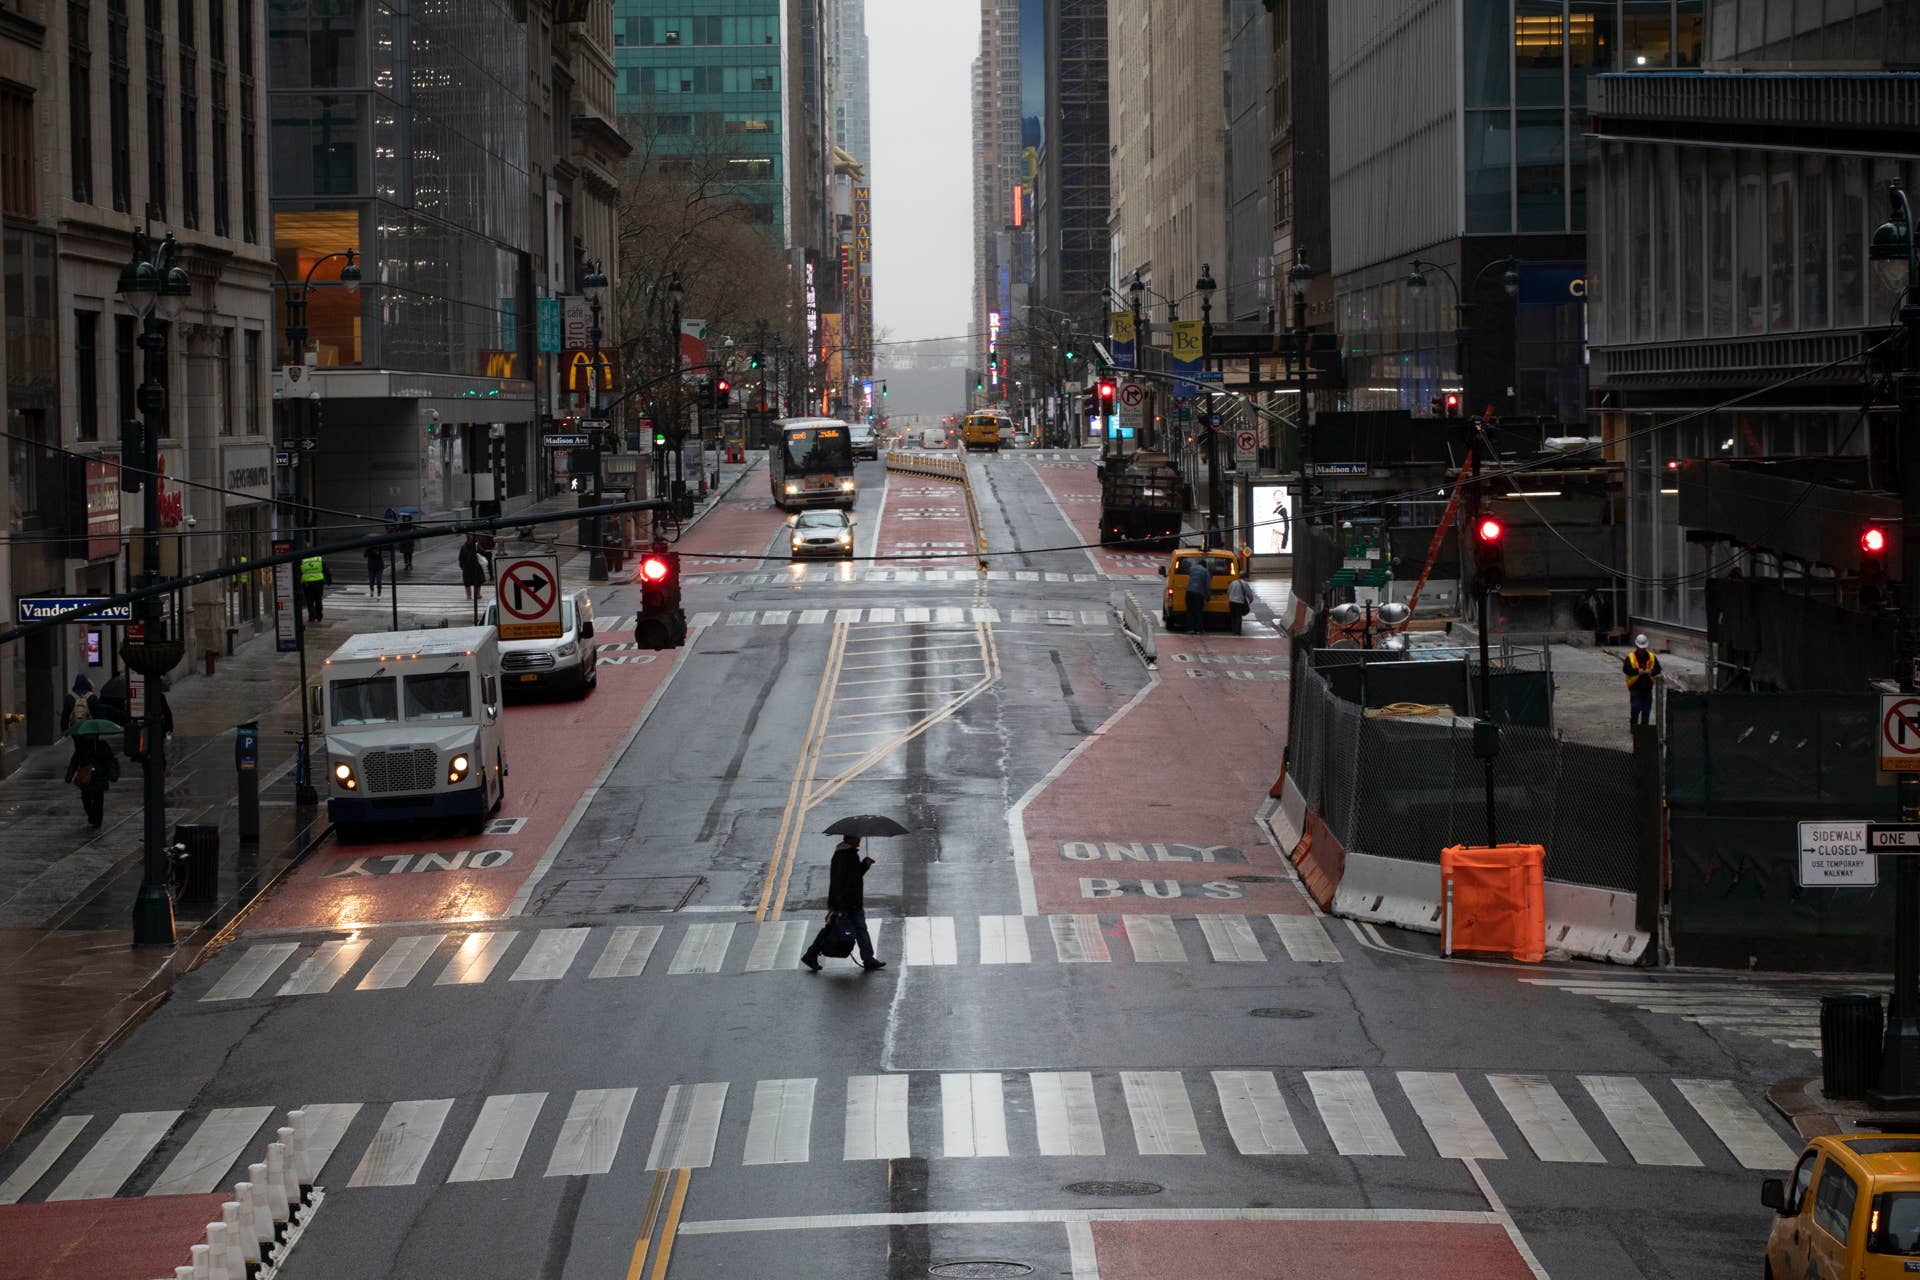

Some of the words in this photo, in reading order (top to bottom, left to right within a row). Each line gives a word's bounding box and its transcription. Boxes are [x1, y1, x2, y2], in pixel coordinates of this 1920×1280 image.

[857, 188, 869, 263] MADAME
[1569, 279, 1588, 296] ci
[568, 321, 584, 349] etro
[1176, 331, 1199, 349] Be
[1316, 465, 1349, 473] Madison
[1352, 465, 1365, 473] Ave
[22, 603, 98, 616] Vander
[101, 606, 129, 616] Ave
[596, 655, 657, 666] ON
[245, 737, 253, 748] P
[1812, 831, 1862, 842] SIDEWALK
[1880, 833, 1905, 845] ONE
[1063, 841, 1229, 862] ONLY
[1818, 845, 1857, 856] CLOSED
[320, 850, 514, 879] ONLY
[1079, 877, 1243, 899] BUS
